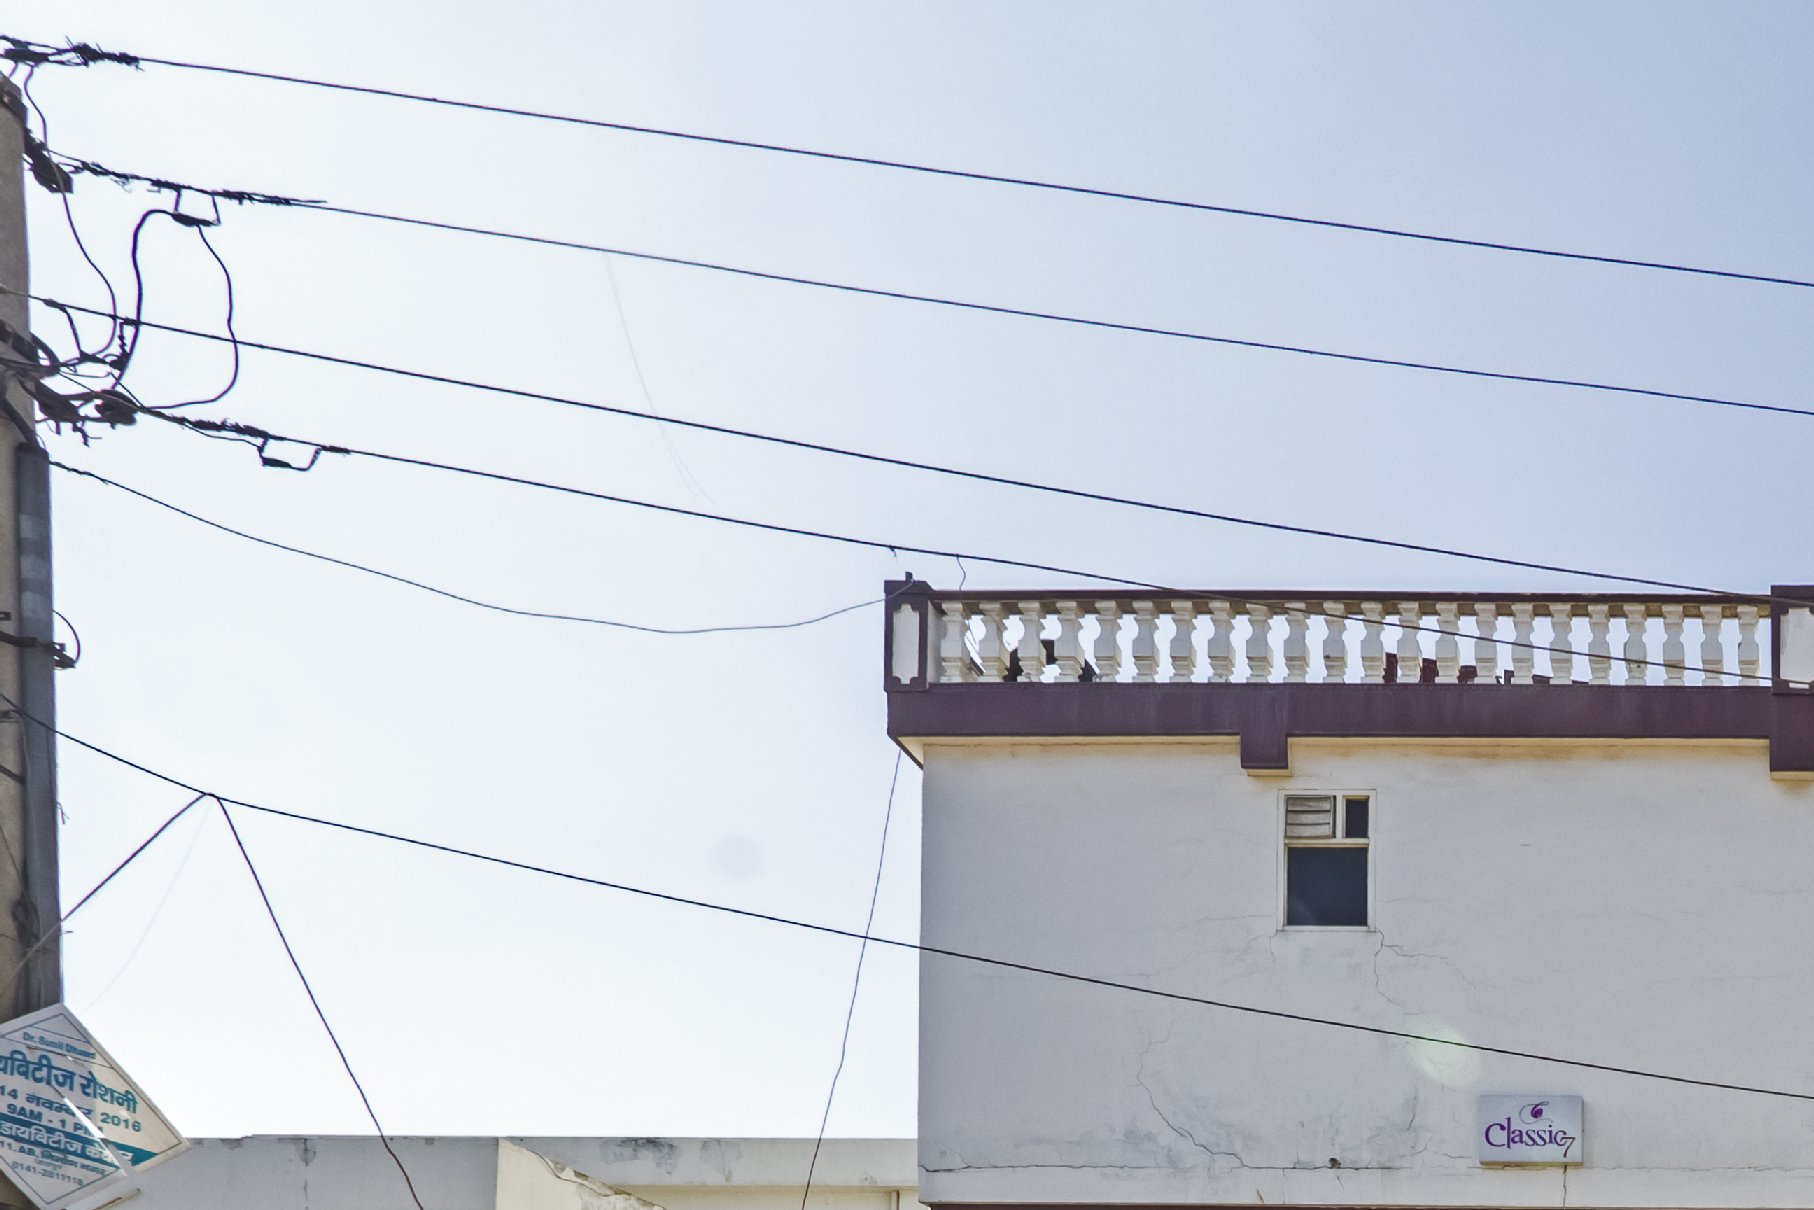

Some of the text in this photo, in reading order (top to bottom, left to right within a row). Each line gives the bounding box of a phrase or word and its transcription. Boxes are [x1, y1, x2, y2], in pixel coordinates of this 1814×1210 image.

[7, 1103, 43, 1122] 9AM
[100, 1112, 142, 1132] 2016
[1484, 1116, 1568, 1150] Classic
